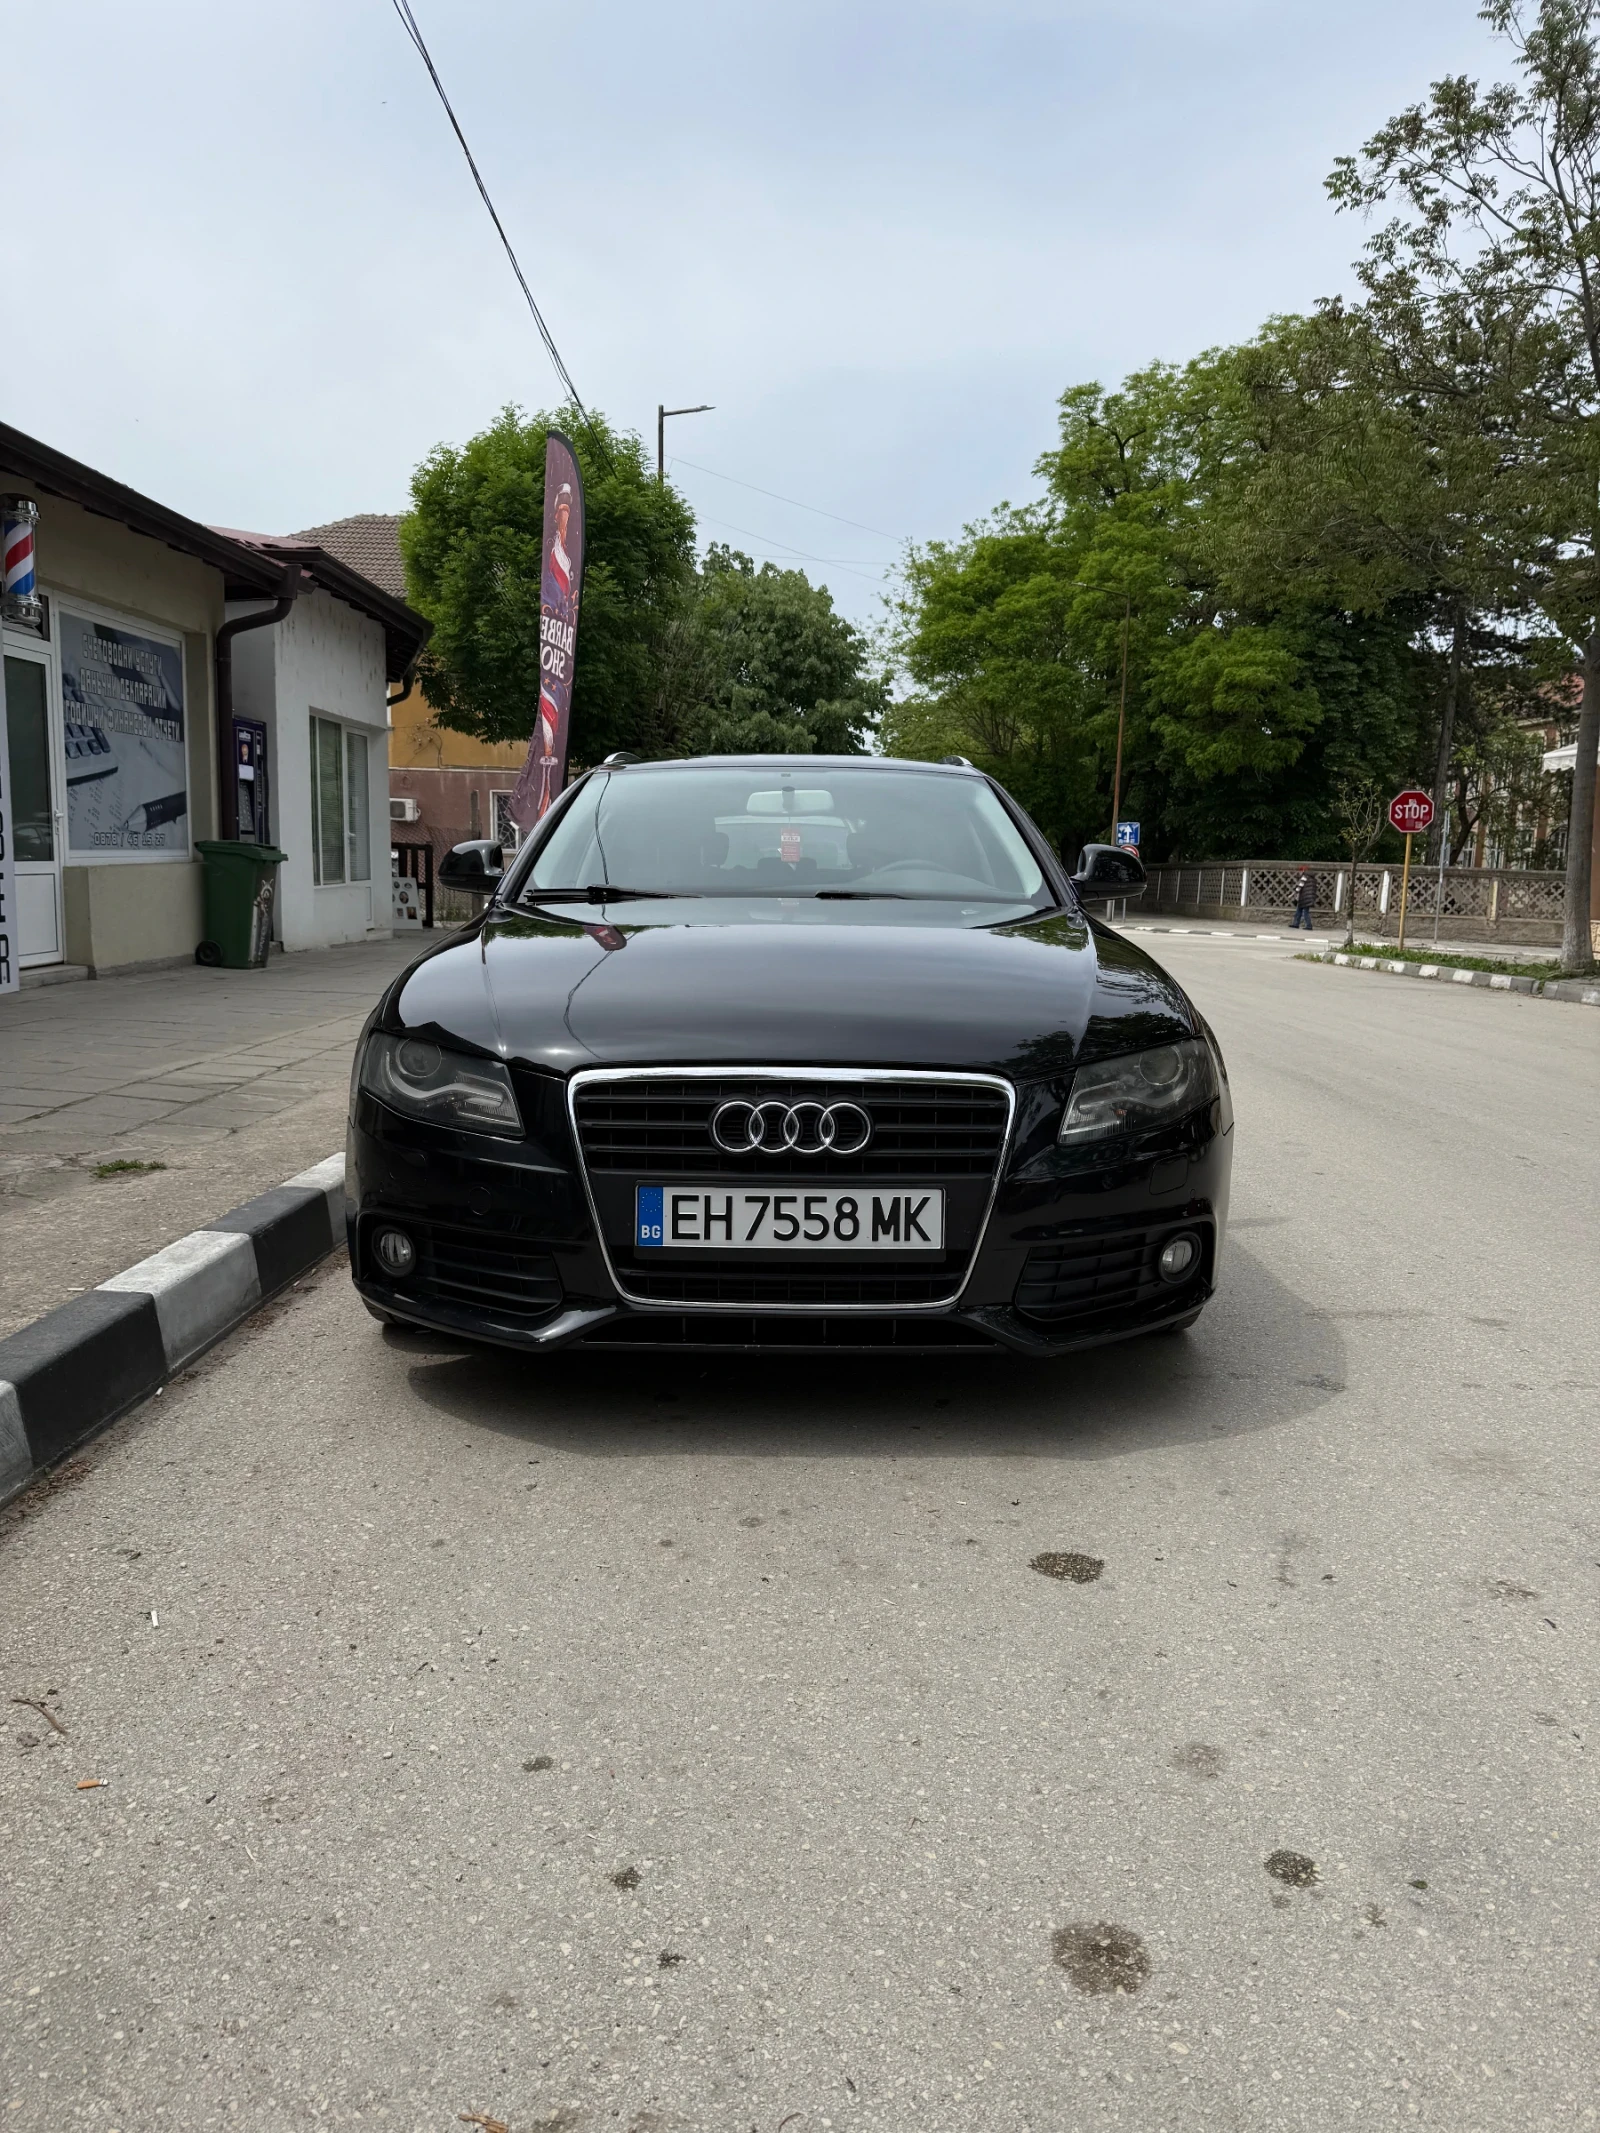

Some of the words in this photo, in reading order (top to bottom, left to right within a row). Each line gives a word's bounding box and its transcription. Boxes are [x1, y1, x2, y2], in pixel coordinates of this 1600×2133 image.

[82, 633, 133, 670] СЧЕТОВОДНИ
[134, 648, 162, 677] УСЛУГИ
[120, 677, 167, 709] ДЕКЛАРАЦИИ
[65, 699, 104, 731] ГОДИШНИ
[107, 706, 153, 739] ФИНАНСОВИ
[155, 717, 180, 743] ОТЧЕТИ
[1394, 804, 1429, 819] STOP
[641, 1224, 661, 1239] BG
[671, 1195, 733, 1240] EH
[745, 1196, 860, 1241] 7558
[871, 1196, 931, 1241] MK
